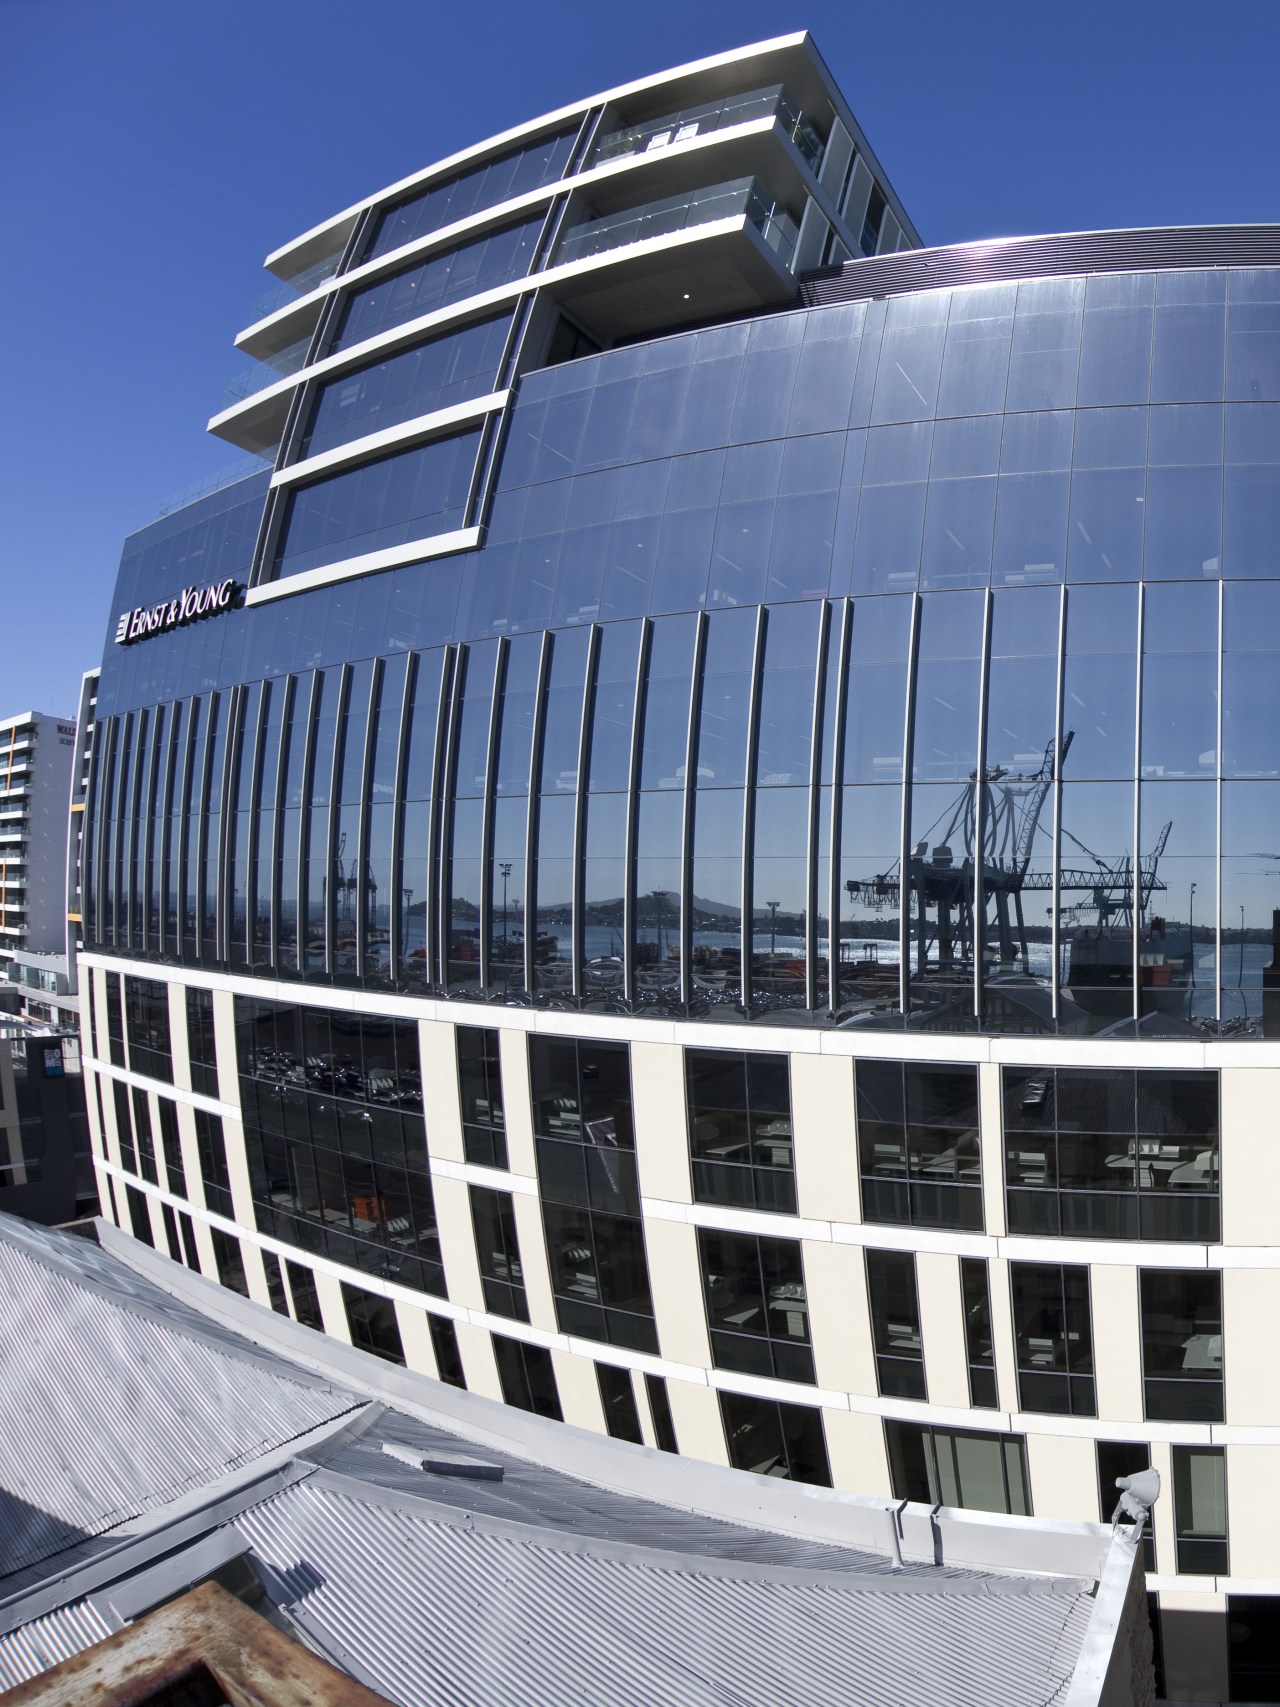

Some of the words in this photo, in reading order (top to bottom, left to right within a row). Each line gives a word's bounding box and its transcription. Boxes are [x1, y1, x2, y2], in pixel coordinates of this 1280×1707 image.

[129, 607, 168, 638] ERNST
[166, 600, 178, 624] &
[179, 579, 233, 620] YOUNG
